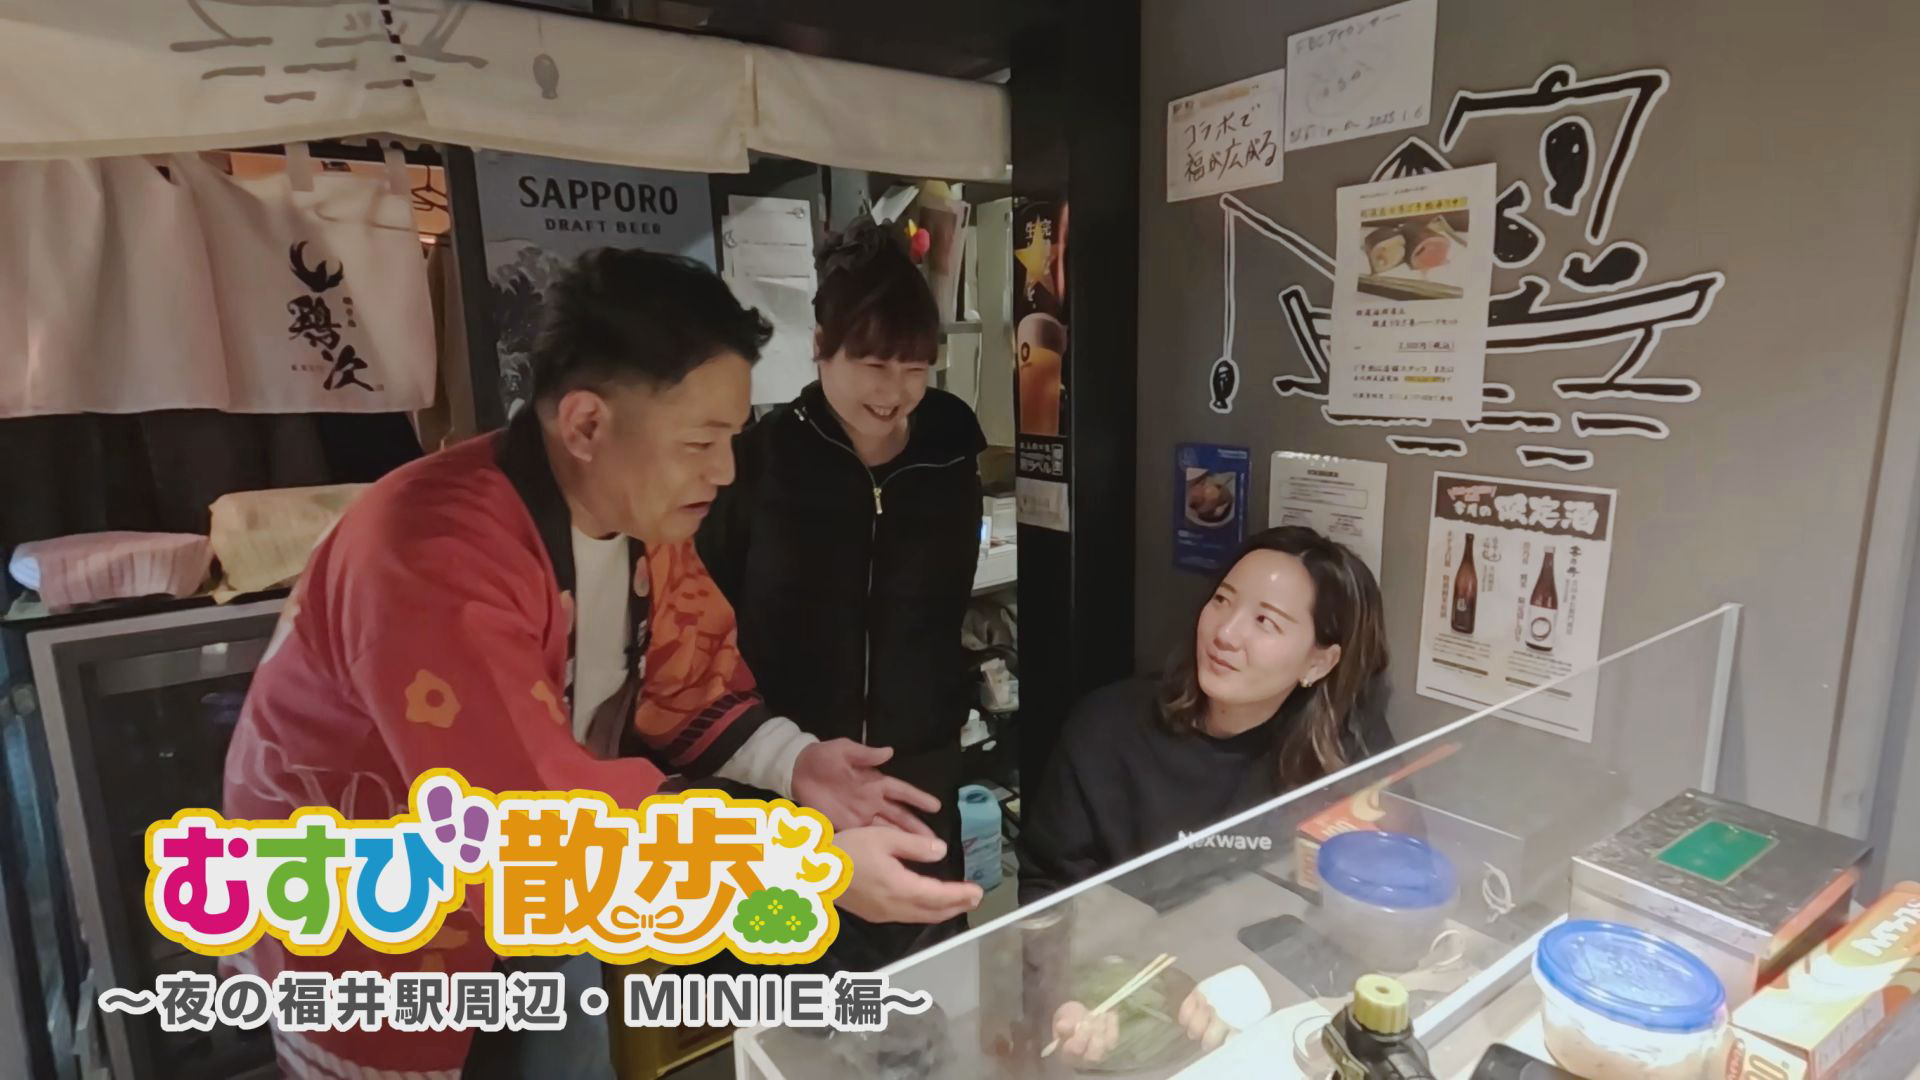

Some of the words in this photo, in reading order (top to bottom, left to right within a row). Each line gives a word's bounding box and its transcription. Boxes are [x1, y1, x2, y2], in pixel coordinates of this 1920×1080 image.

[518, 175, 679, 215] SAPPORO
[544, 218, 607, 233] DRAFT
[616, 221, 662, 235] BEER
